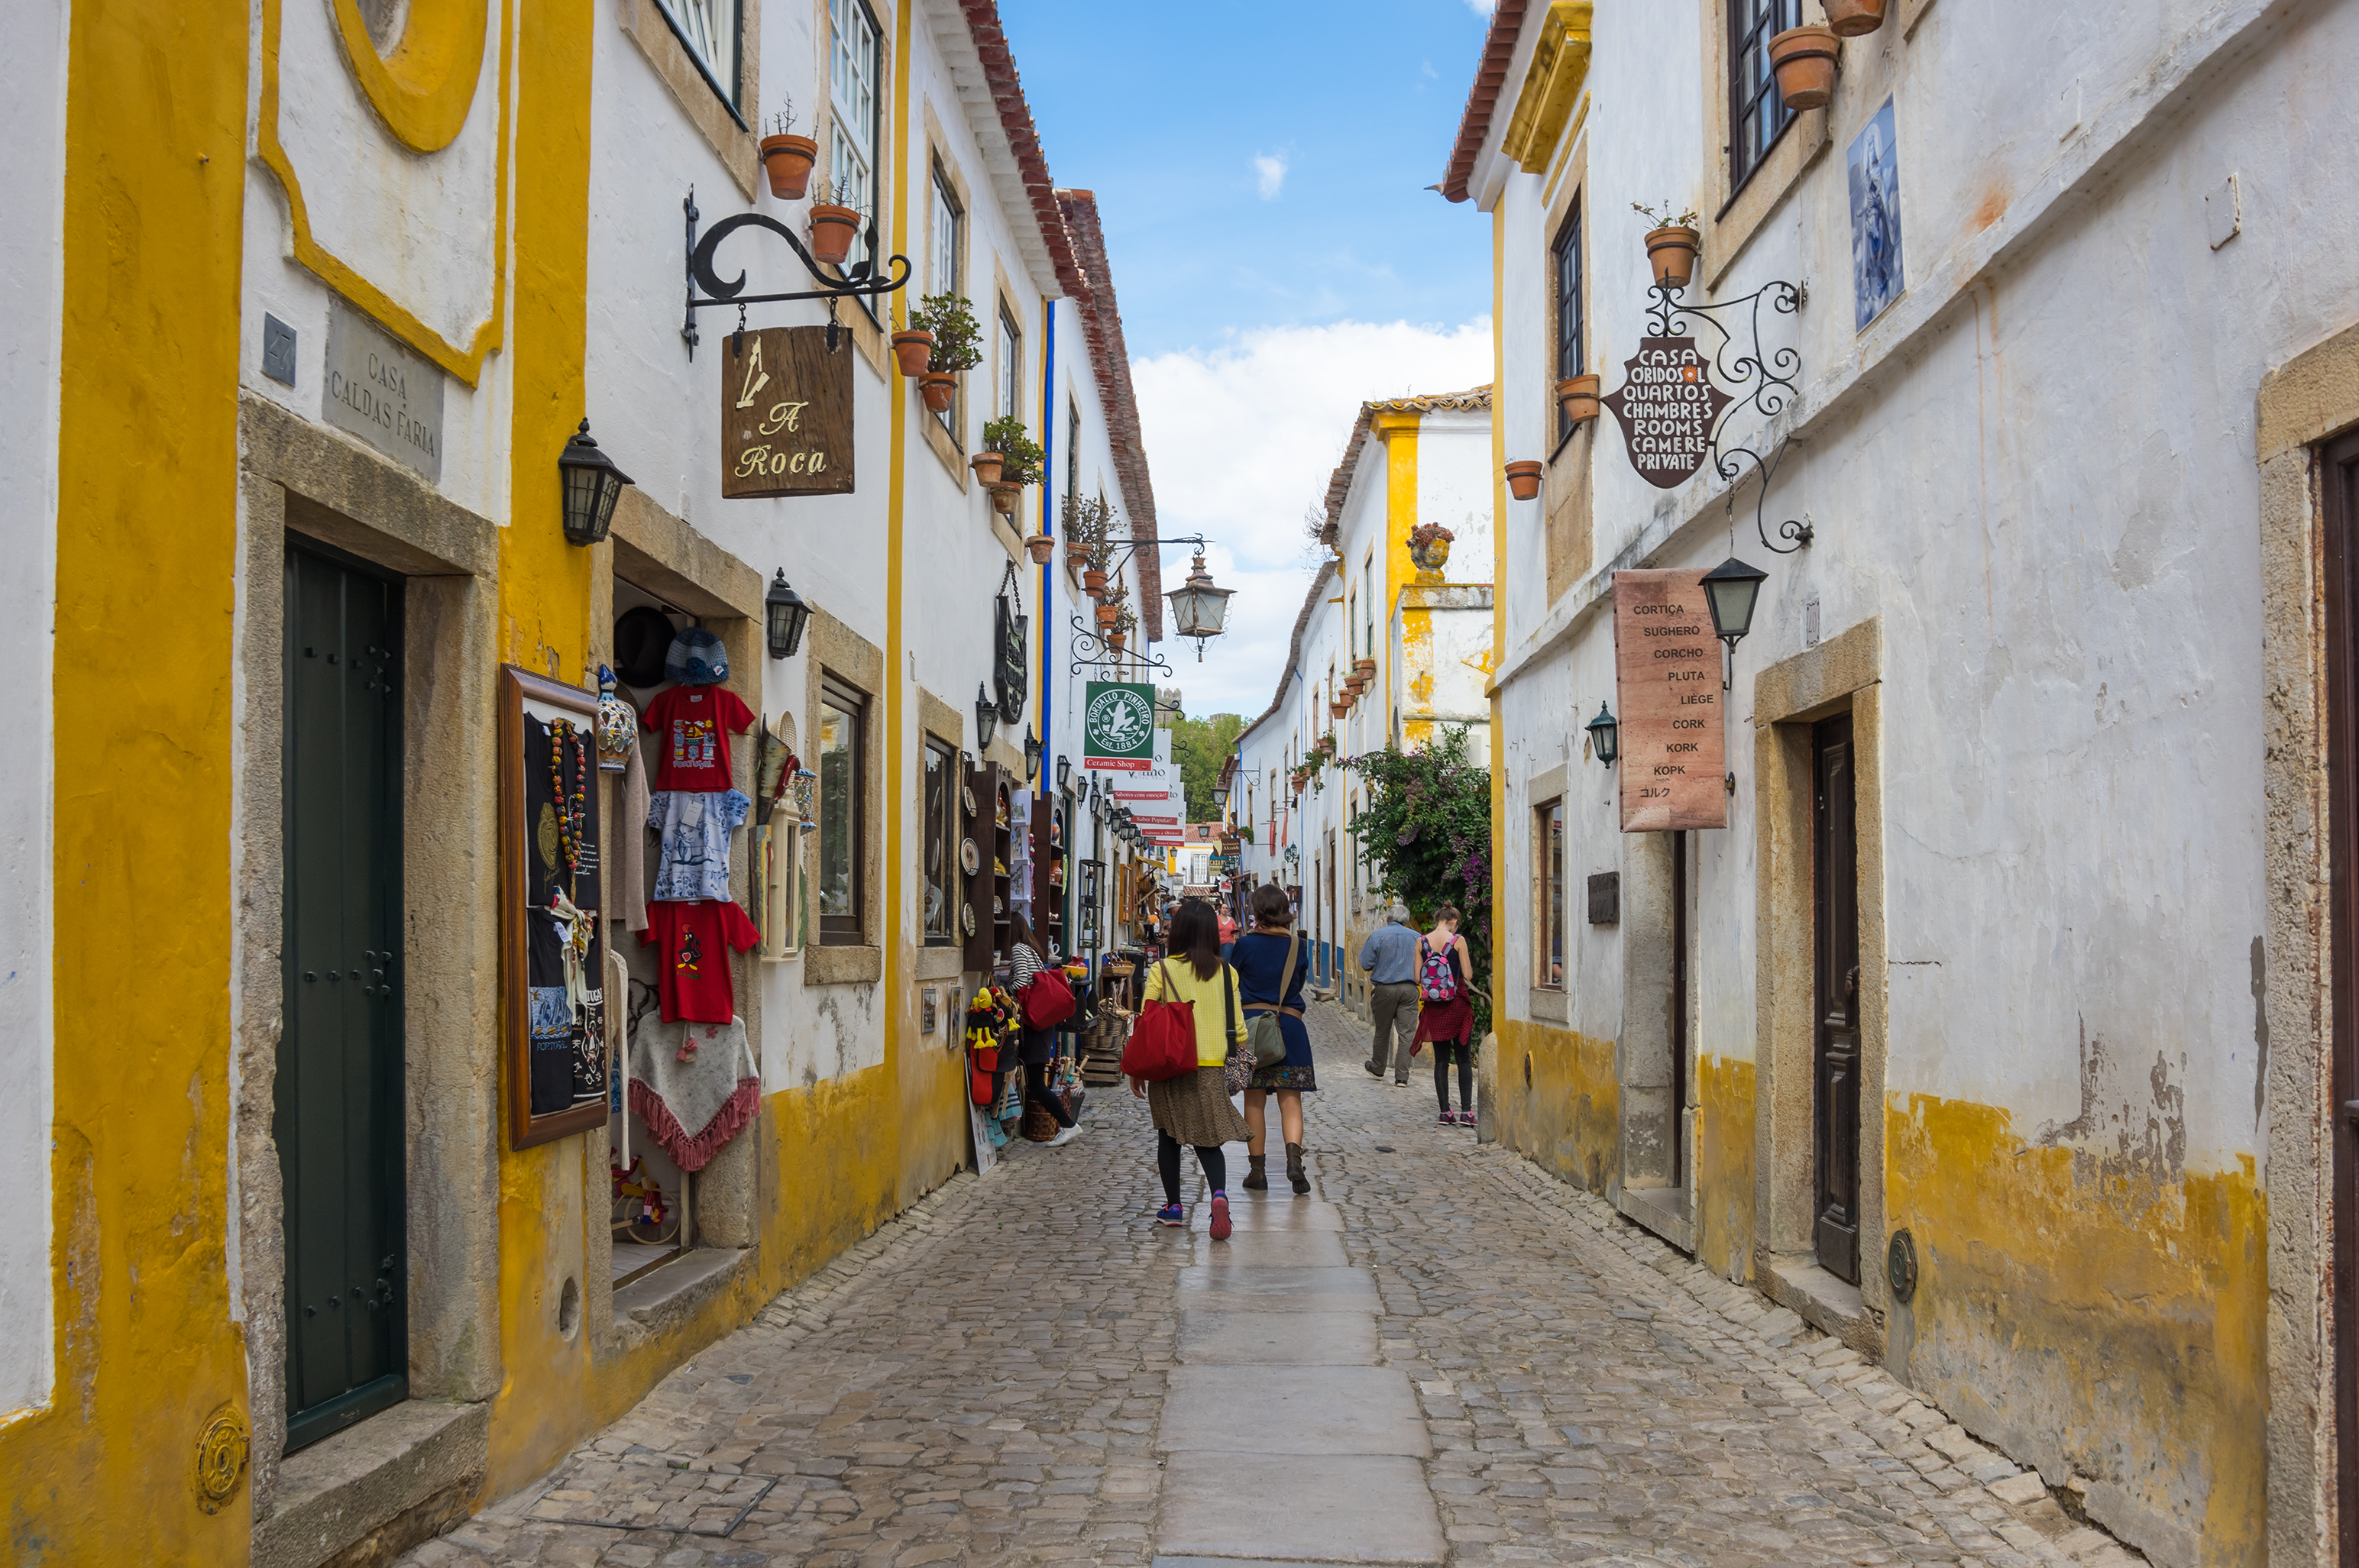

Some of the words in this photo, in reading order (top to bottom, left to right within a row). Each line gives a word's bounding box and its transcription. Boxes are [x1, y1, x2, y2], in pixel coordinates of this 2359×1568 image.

[1639, 348, 1697, 366] CASA
[368, 352, 407, 401] CASA
[1623, 384, 1712, 402] QUARTOS
[332, 370, 392, 430] CALDAS
[397, 409, 435, 458] FARIA
[759, 401, 810, 435] A
[1623, 402, 1713, 419] CHAMBRES
[1634, 419, 1704, 436] ROOMS
[1632, 436, 1706, 453] CAMERE
[734, 444, 827, 478] Roca
[1637, 454, 1695, 470] PRIVATE
[1633, 604, 1684, 616] CORTIÇA
[1644, 626, 1700, 637] SUGHERO
[1654, 648, 1704, 660] CORCHO
[1668, 671, 1706, 681] PLUTA
[1681, 693, 1714, 705] LIÈGE
[1089, 691, 1118, 723] BORDALLO
[1123, 692, 1150, 725] PINHEIRO
[1672, 719, 1706, 729] CORK
[1100, 737, 1114, 749] Est.
[1116, 739, 1137, 750] 1884
[1666, 742, 1699, 753] KORK
[1086, 758, 1116, 767] Ceramic
[1117, 760, 1135, 769] Shop
[1640, 787, 1671, 798] コルク
